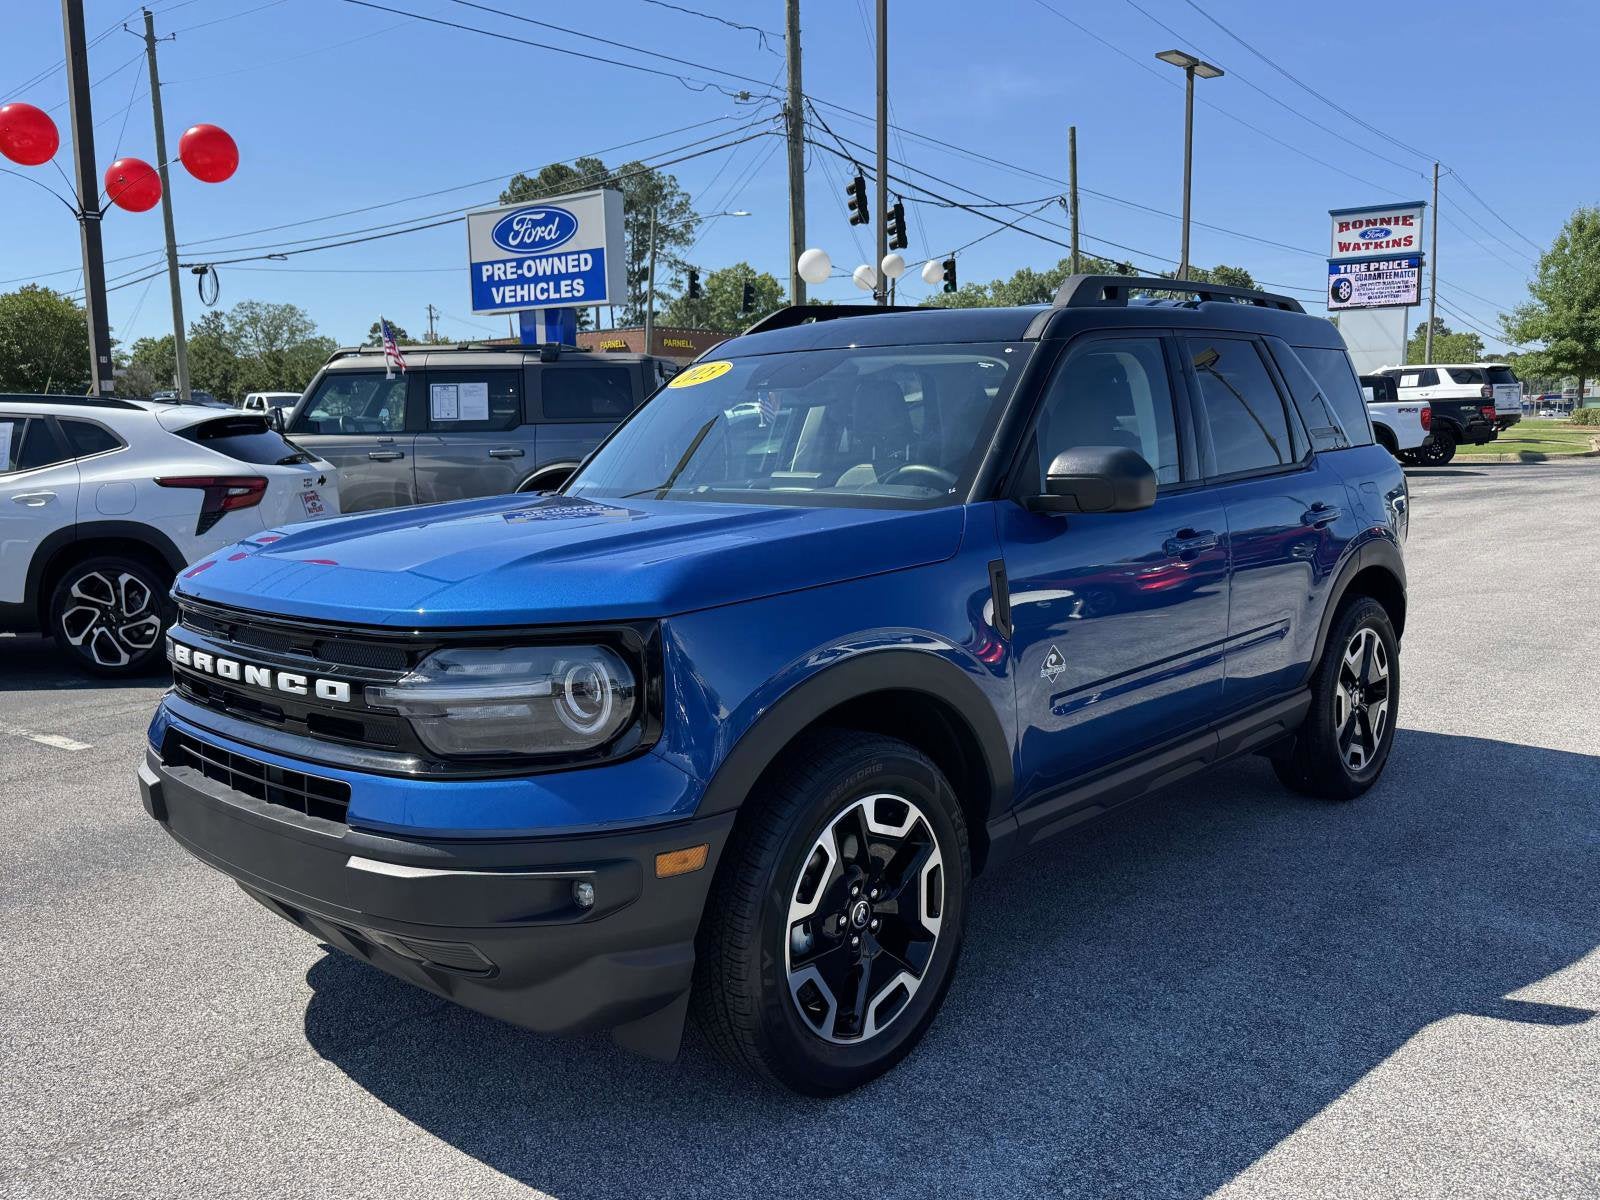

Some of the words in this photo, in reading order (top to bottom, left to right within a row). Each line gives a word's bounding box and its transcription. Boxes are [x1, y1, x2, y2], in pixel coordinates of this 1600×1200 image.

[509, 212, 560, 246] Ford
[1338, 215, 1414, 233] RONNIE
[1365, 229, 1386, 239] Ford
[1337, 235, 1414, 252] WATKINS
[482, 253, 592, 282] PRE-OWNED
[1338, 262, 1369, 274] TIRE
[1369, 259, 1409, 271] PRICE
[1355, 271, 1392, 282] GUARANTEE
[1393, 270, 1416, 279] MATCH
[491, 279, 585, 304] VEHICLES
[600, 339, 626, 349] PARNELL
[663, 338, 694, 349] PARNELL
[174, 644, 350, 703] BRONCO
